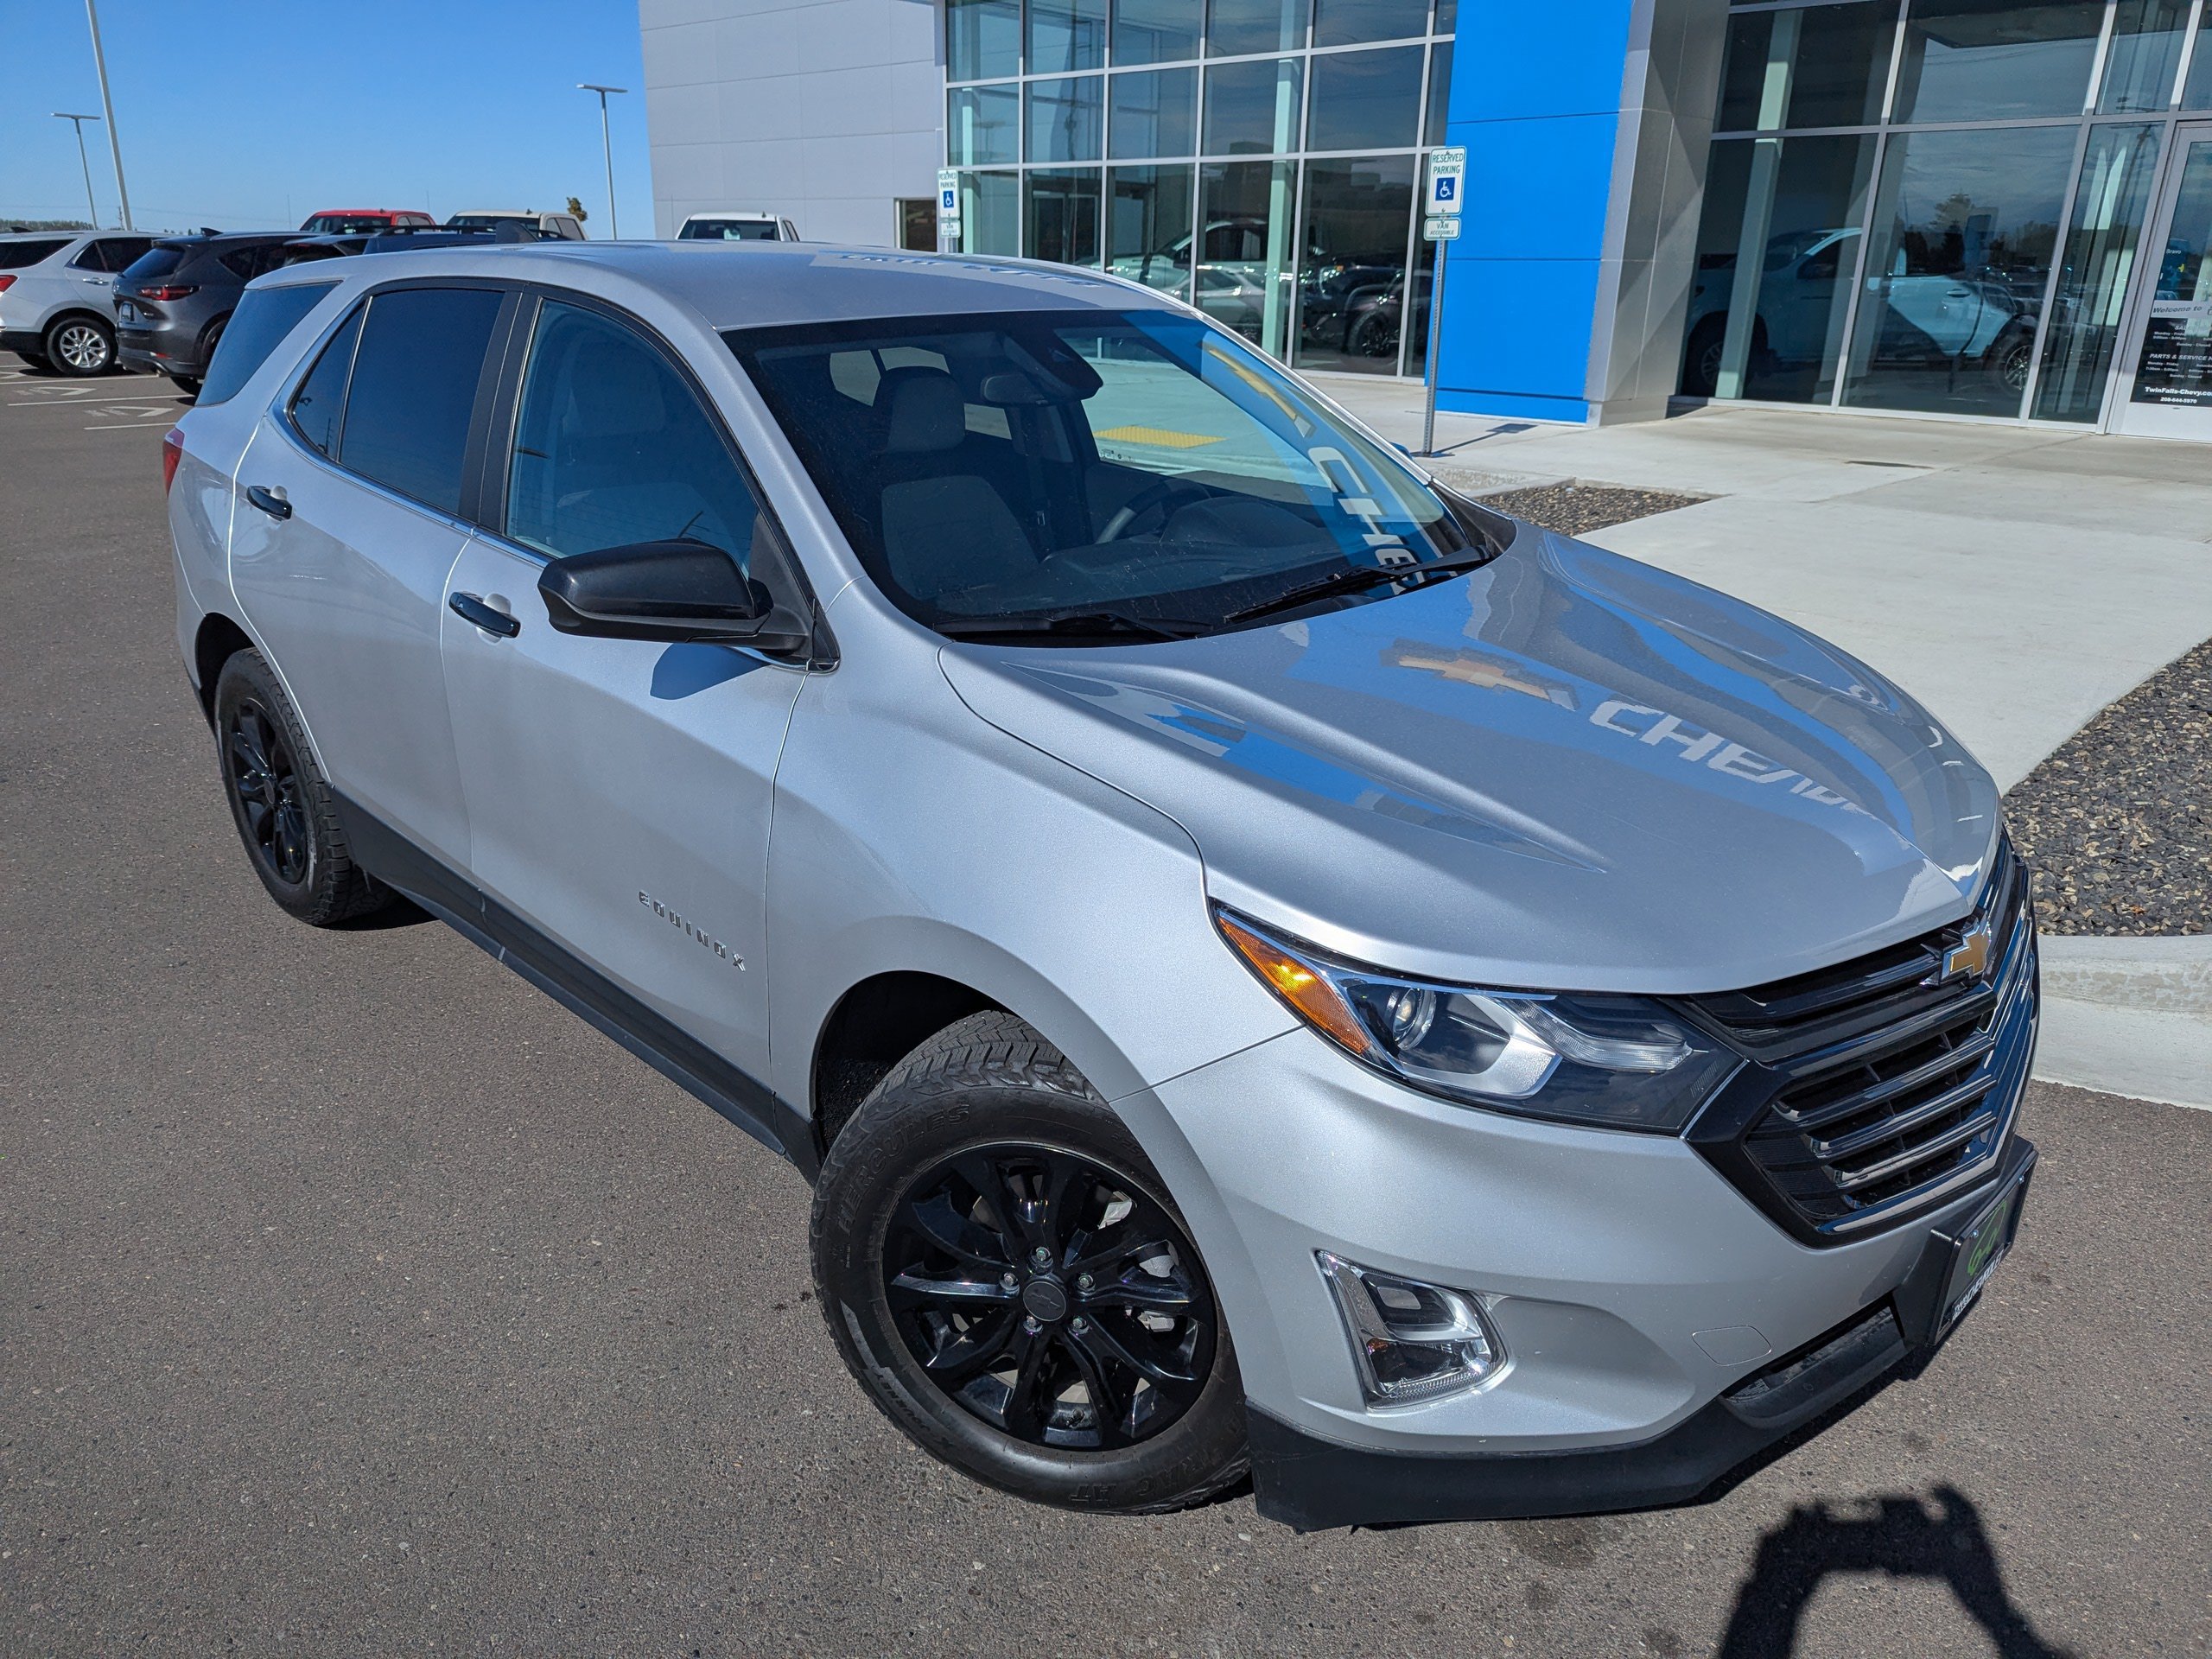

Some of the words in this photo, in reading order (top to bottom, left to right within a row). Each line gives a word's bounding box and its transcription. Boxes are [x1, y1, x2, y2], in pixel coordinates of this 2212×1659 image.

[1433, 153, 1464, 162] RESERVED
[1433, 164, 1460, 175] PARKING
[639, 889, 746, 972] EQUINOX
[837, 1103, 971, 1237] HERCULES
